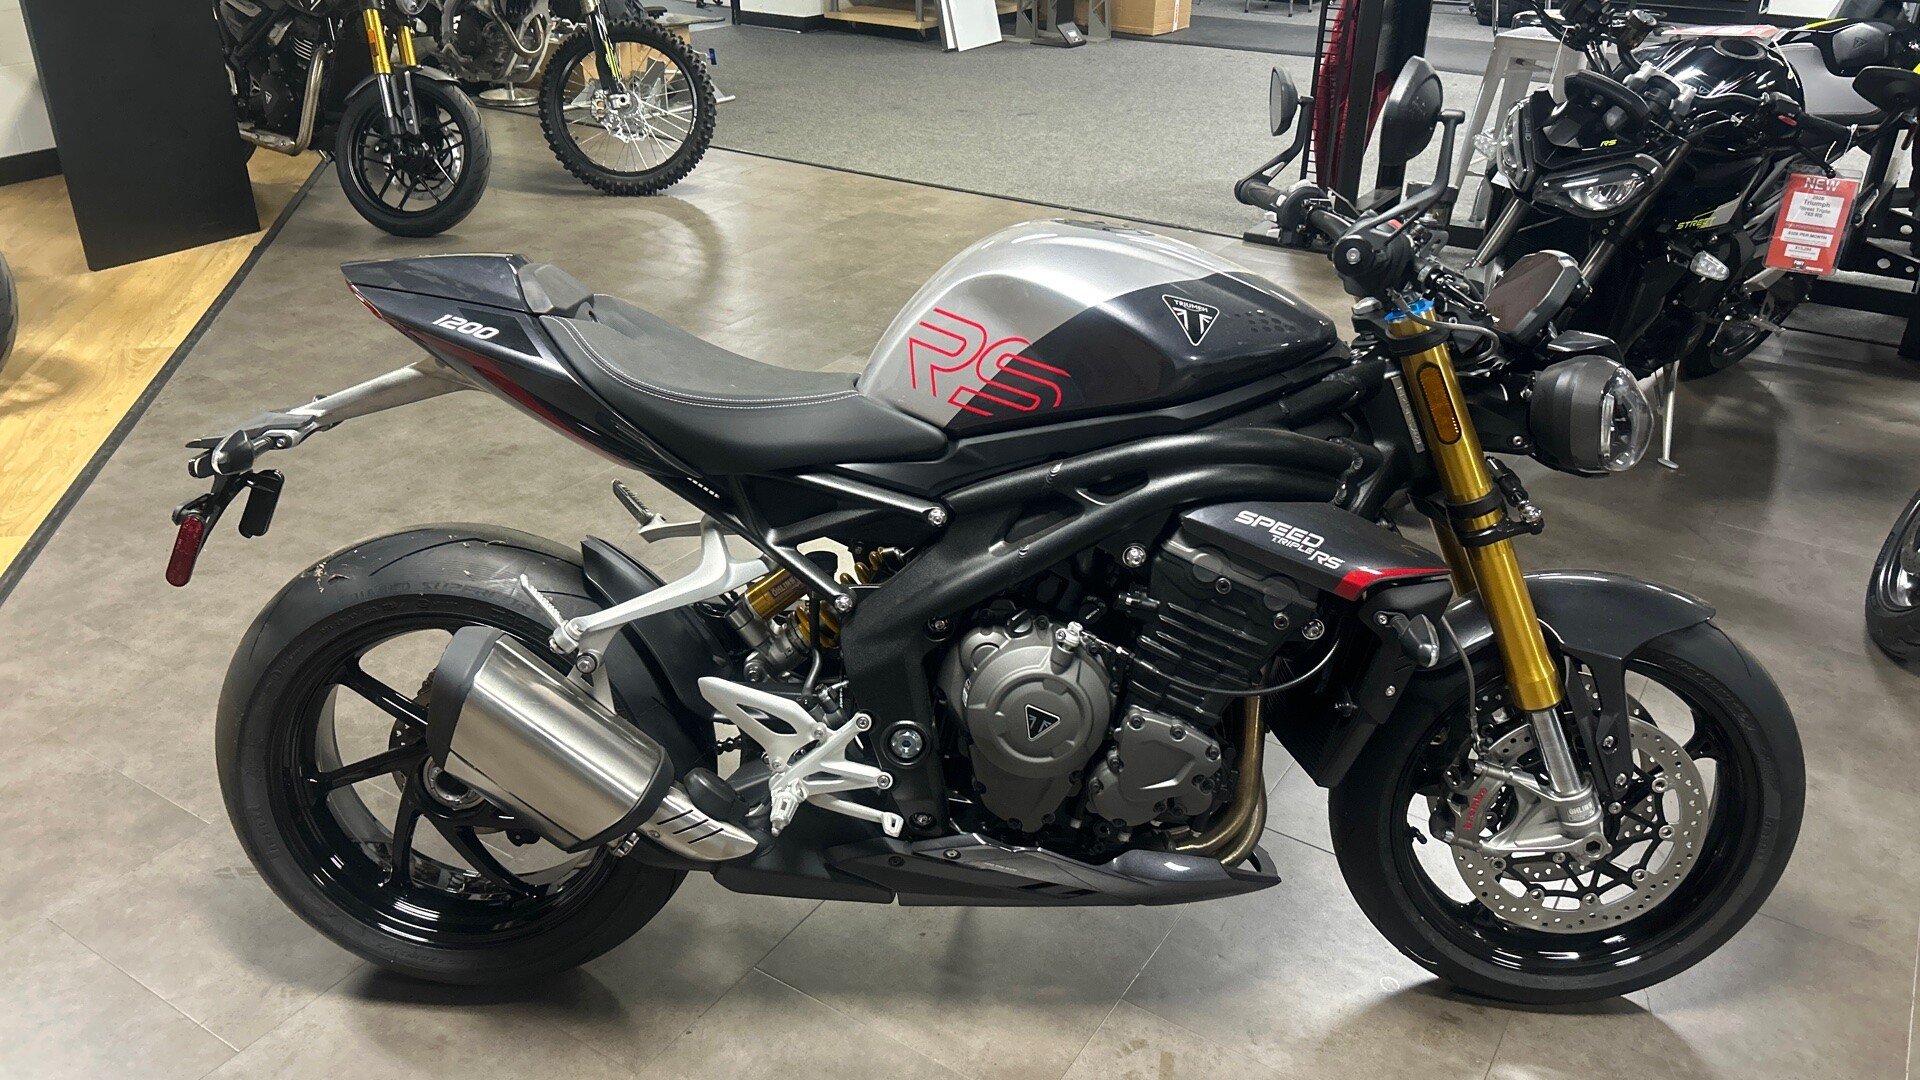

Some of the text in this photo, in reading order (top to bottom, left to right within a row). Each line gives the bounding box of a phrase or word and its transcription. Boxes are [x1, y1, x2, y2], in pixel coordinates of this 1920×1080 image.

[1600, 139, 1618, 148] RS
[1804, 176, 1841, 192] NEW
[1804, 199, 1831, 208] Triumph
[1676, 216, 1717, 230] STREET
[1173, 299, 1209, 313] TRIUMPH
[432, 314, 500, 340] 1200
[908, 306, 1072, 417] RS
[1234, 510, 1325, 548] SPEED
[1271, 534, 1346, 570] TRIPLE RS
[1463, 786, 1488, 832] brembo
